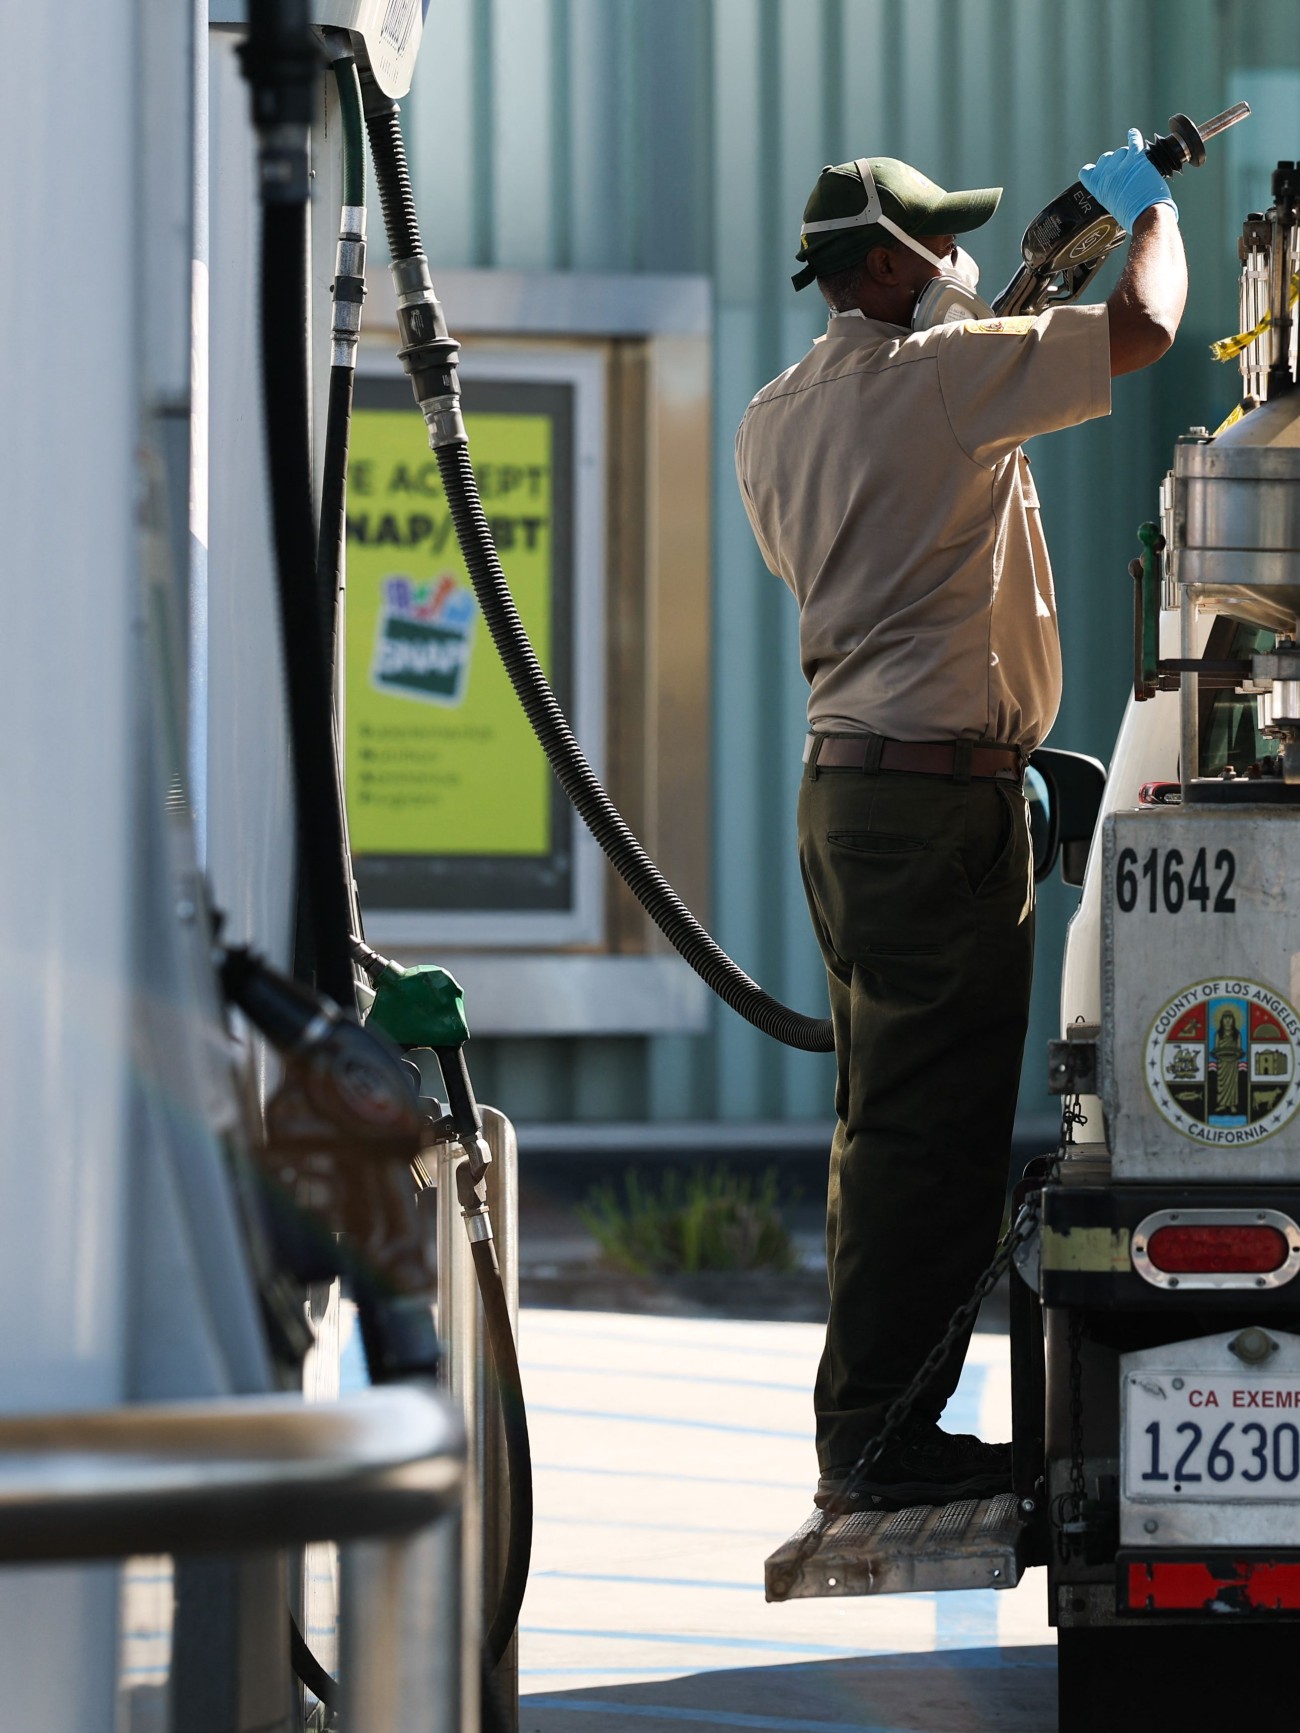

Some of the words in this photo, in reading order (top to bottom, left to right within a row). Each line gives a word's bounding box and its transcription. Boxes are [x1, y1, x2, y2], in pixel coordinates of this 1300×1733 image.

[1074, 190, 1092, 214] EVR
[389, 460, 543, 498] ACEPT
[1116, 847, 1236, 914] 61642
[1155, 989, 1199, 1035] COUNTY
[1202, 983, 1221, 996] OF
[1225, 982, 1250, 996] LOS
[1252, 990, 1300, 1036] ANGELES
[1188, 1123, 1269, 1144] CALIFORNIA
[1189, 1390, 1219, 1408] CA
